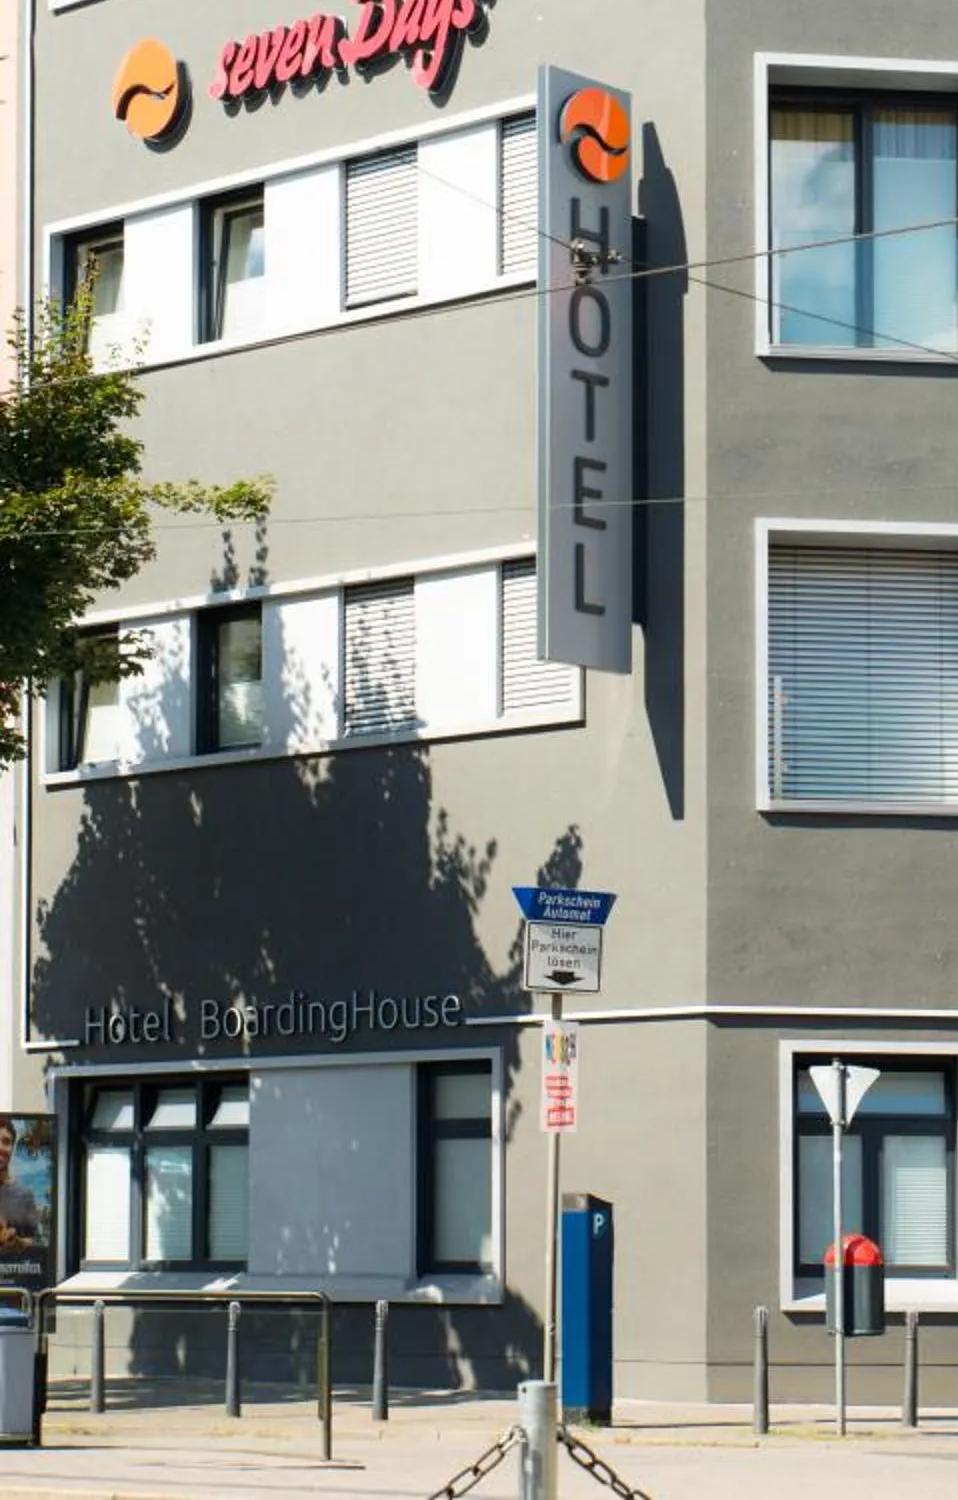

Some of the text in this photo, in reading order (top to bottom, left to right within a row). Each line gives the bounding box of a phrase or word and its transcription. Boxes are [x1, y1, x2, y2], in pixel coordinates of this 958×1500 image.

[207, 12, 338, 100] seven
[569, 197, 611, 617] HOTEL
[551, 927, 577, 940] Hier
[85, 988, 462, 1046] Hotel BoardingHouse
[593, 1212, 605, 1235] P
